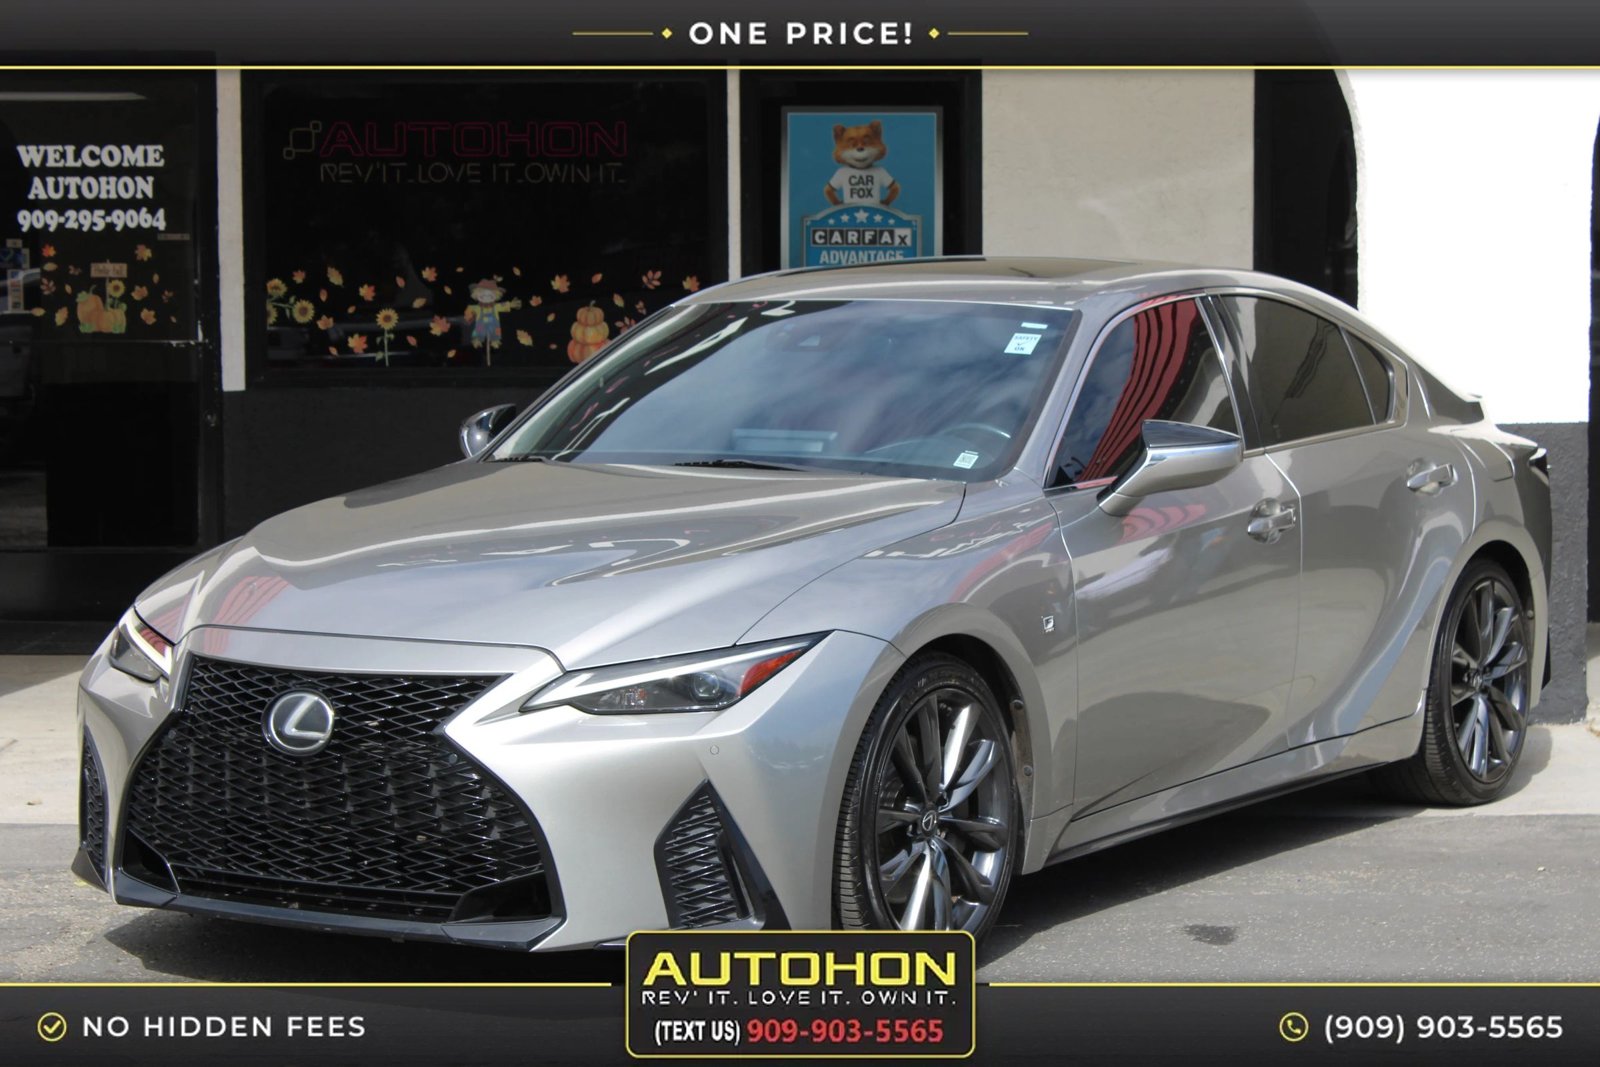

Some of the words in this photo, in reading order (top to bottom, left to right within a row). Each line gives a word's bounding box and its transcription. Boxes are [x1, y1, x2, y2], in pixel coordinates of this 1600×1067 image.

[319, 120, 628, 159] AUTOHON
[16, 144, 165, 169] WELCOME
[418, 161, 481, 184] LOVE
[525, 161, 591, 184] OWN
[848, 174, 874, 187] CAR
[27, 175, 155, 200] AUTOHON
[850, 187, 873, 199] FOX
[17, 207, 166, 232] 909-295-9064
[813, 230, 910, 247] CARFAX
[819, 249, 904, 266] ADVANTAGE
